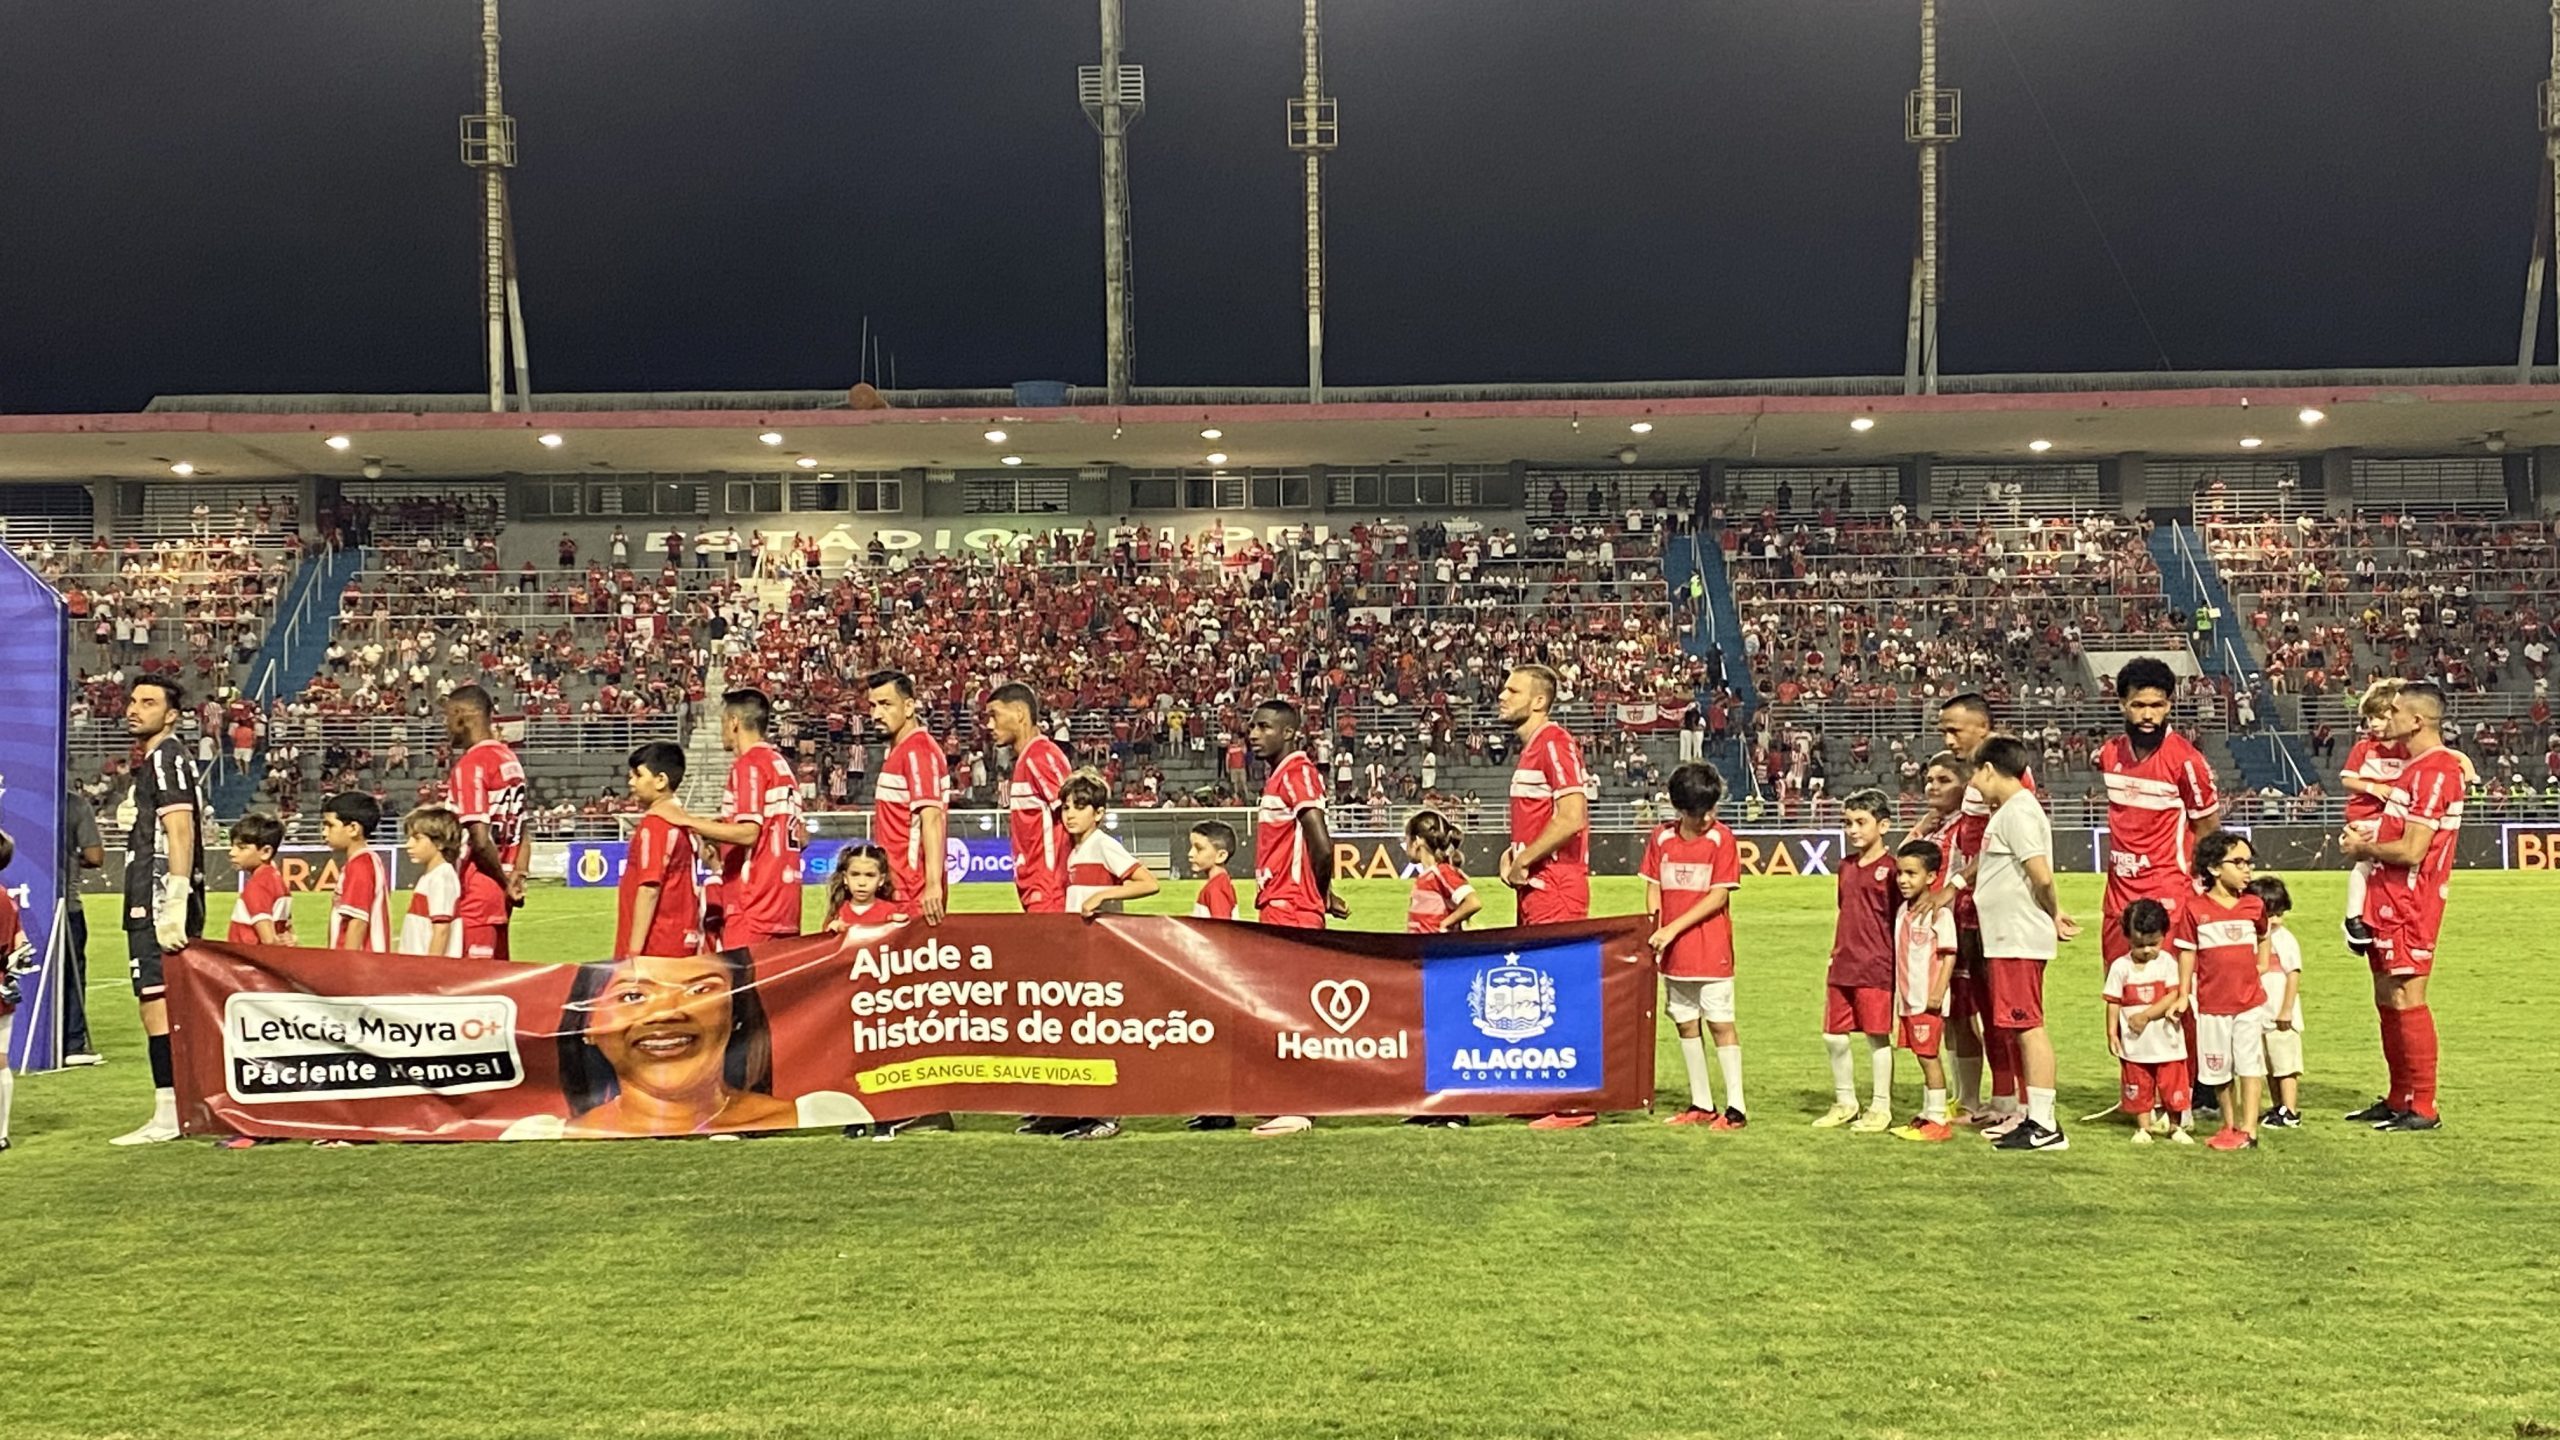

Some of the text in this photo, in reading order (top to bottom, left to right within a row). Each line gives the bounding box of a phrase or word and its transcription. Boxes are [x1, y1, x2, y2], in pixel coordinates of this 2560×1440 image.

[1737, 841, 1832, 876] RAX
[849, 938, 993, 984] Ajude a
[850, 980, 1125, 1016] escrever novas
[357, 1016, 457, 1047] Mayra
[853, 1009, 1215, 1053] histórias de doação
[1277, 1030, 1408, 1060] Hemoal
[242, 1060, 377, 1086] Paciente
[1452, 1047, 1577, 1070] ALAGOAS
[875, 1070, 911, 1086] DOE
[992, 1065, 1040, 1080] SALVE
[1045, 1067, 1097, 1081] VIDAS.
[1462, 1068, 1567, 1081] GOVERNO
